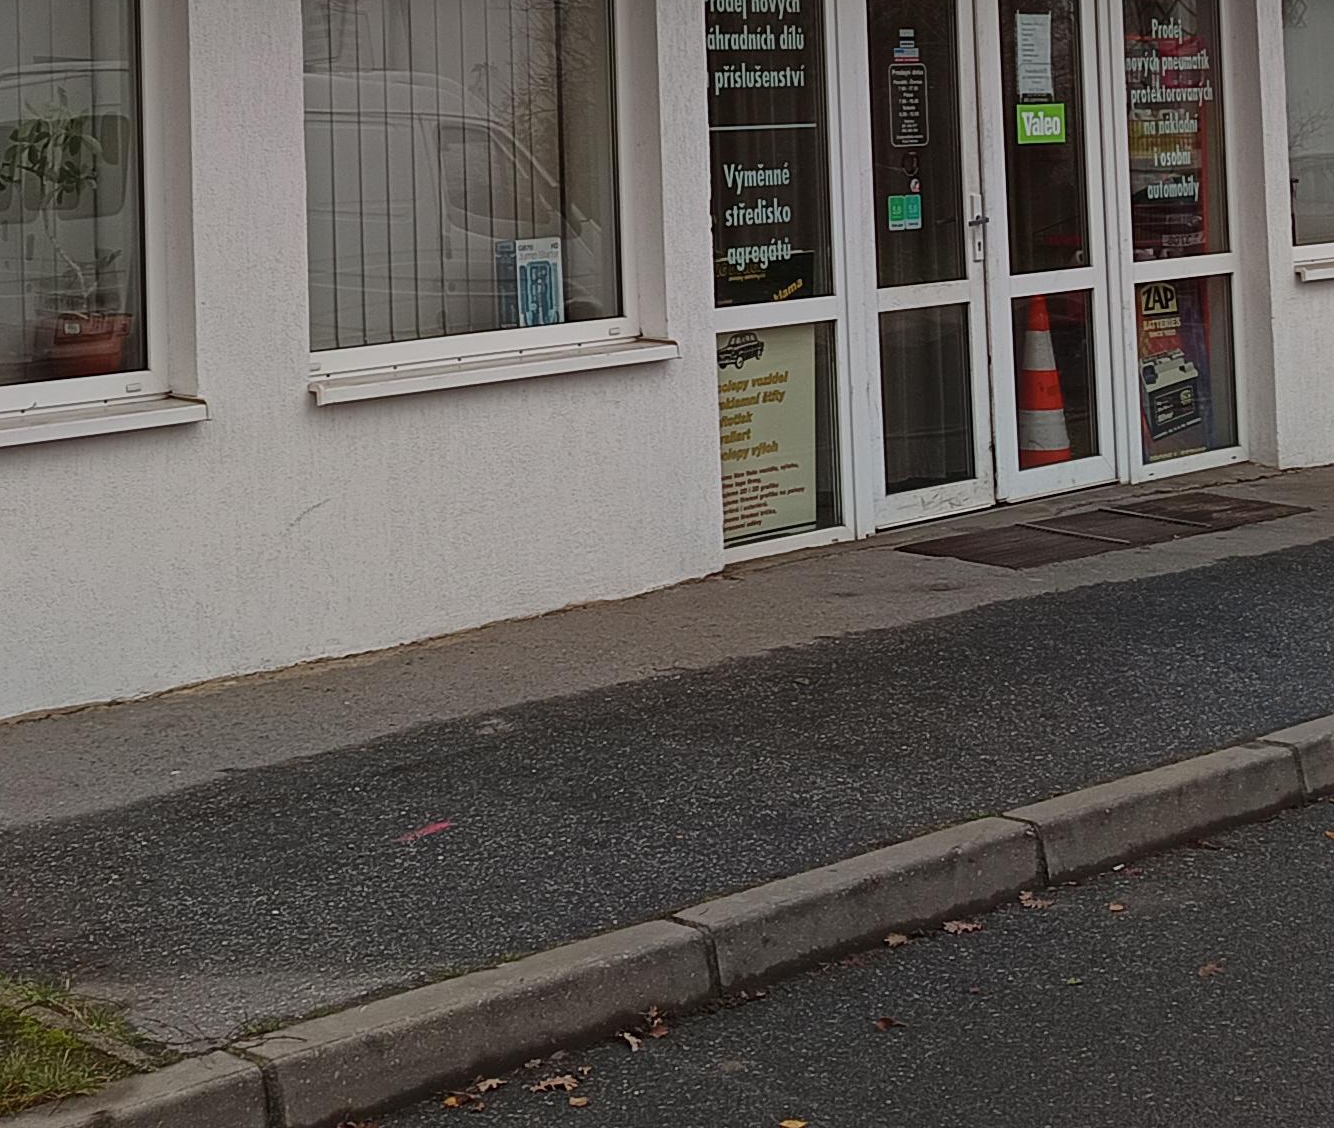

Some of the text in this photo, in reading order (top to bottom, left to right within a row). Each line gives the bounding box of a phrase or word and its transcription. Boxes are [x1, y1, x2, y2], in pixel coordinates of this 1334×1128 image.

[707, 25, 804, 50] áhradních dílů
[1152, 17, 1183, 44] Prodej
[1125, 49, 1209, 77] nových pneumatik
[715, 62, 804, 96] příslušenství
[1131, 79, 1213, 109] protektorovaných
[1021, 111, 1060, 137] Valeo
[1159, 112, 1198, 135] nákladní
[723, 162, 790, 195] Výměnné
[1147, 175, 1200, 202] automobily
[725, 198, 791, 226] středisko
[727, 237, 792, 271] agregátů
[1142, 285, 1175, 311] ZAP
[719, 379, 749, 393] olepy
[721, 448, 750, 462] olepy
